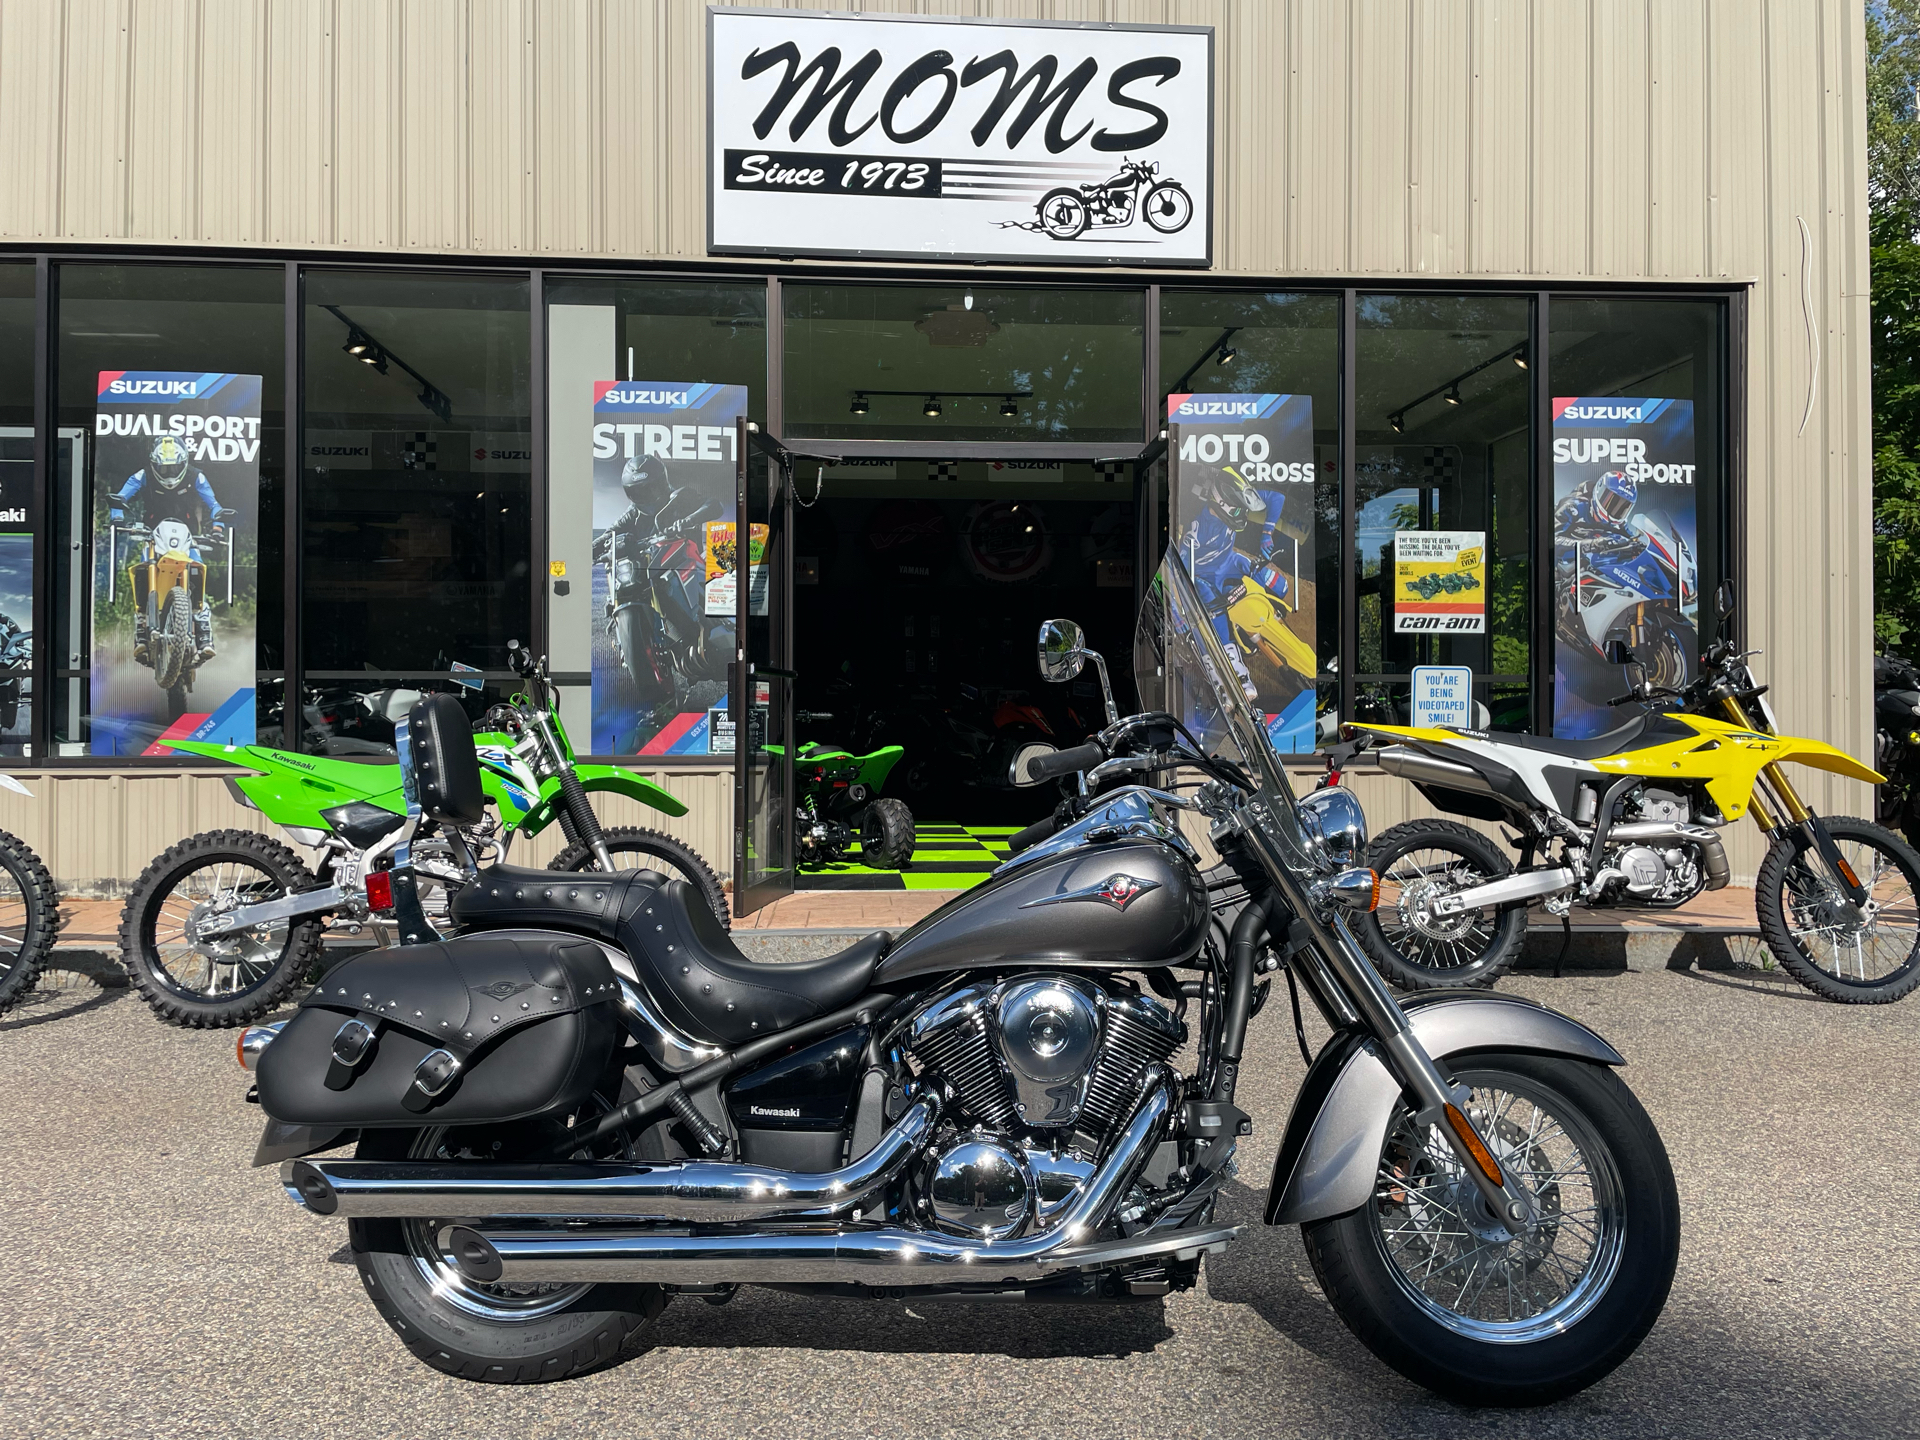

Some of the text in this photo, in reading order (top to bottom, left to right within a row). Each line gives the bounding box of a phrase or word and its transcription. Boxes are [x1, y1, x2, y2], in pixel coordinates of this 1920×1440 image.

[741, 40, 1182, 154] MOMS
[735, 154, 930, 191] Since 1973
[109, 379, 197, 396] SUZUKI
[604, 390, 688, 405] SUZUKI
[1178, 402, 1257, 416] SUZUKI
[1563, 405, 1642, 420] SUZUKI
[310, 446, 369, 456] SUZUKI
[490, 450, 532, 460] SUZU
[1179, 434, 1270, 463] MOTO
[1552, 437, 1647, 465] SUPER
[1240, 463, 1315, 483] CROSS
[1625, 463, 1695, 485] SPORT
[1461, 557, 1477, 567] EVENT
[899, 565, 930, 576] YAMAHA
[1613, 567, 1641, 589] SUZUKI
[1399, 616, 1481, 629] can-am
[1425, 675, 1459, 686] YOU ARE
[1430, 688, 1453, 698] BEING
[1418, 700, 1465, 711] VIDEOTAPED
[1428, 713, 1455, 723] SMILE!
[196, 719, 217, 740] DR-Z4S
[1457, 728, 1490, 739] SUZUKI
[271, 752, 316, 771] Kawasaki
[750, 1105, 800, 1117] Kawasaki
